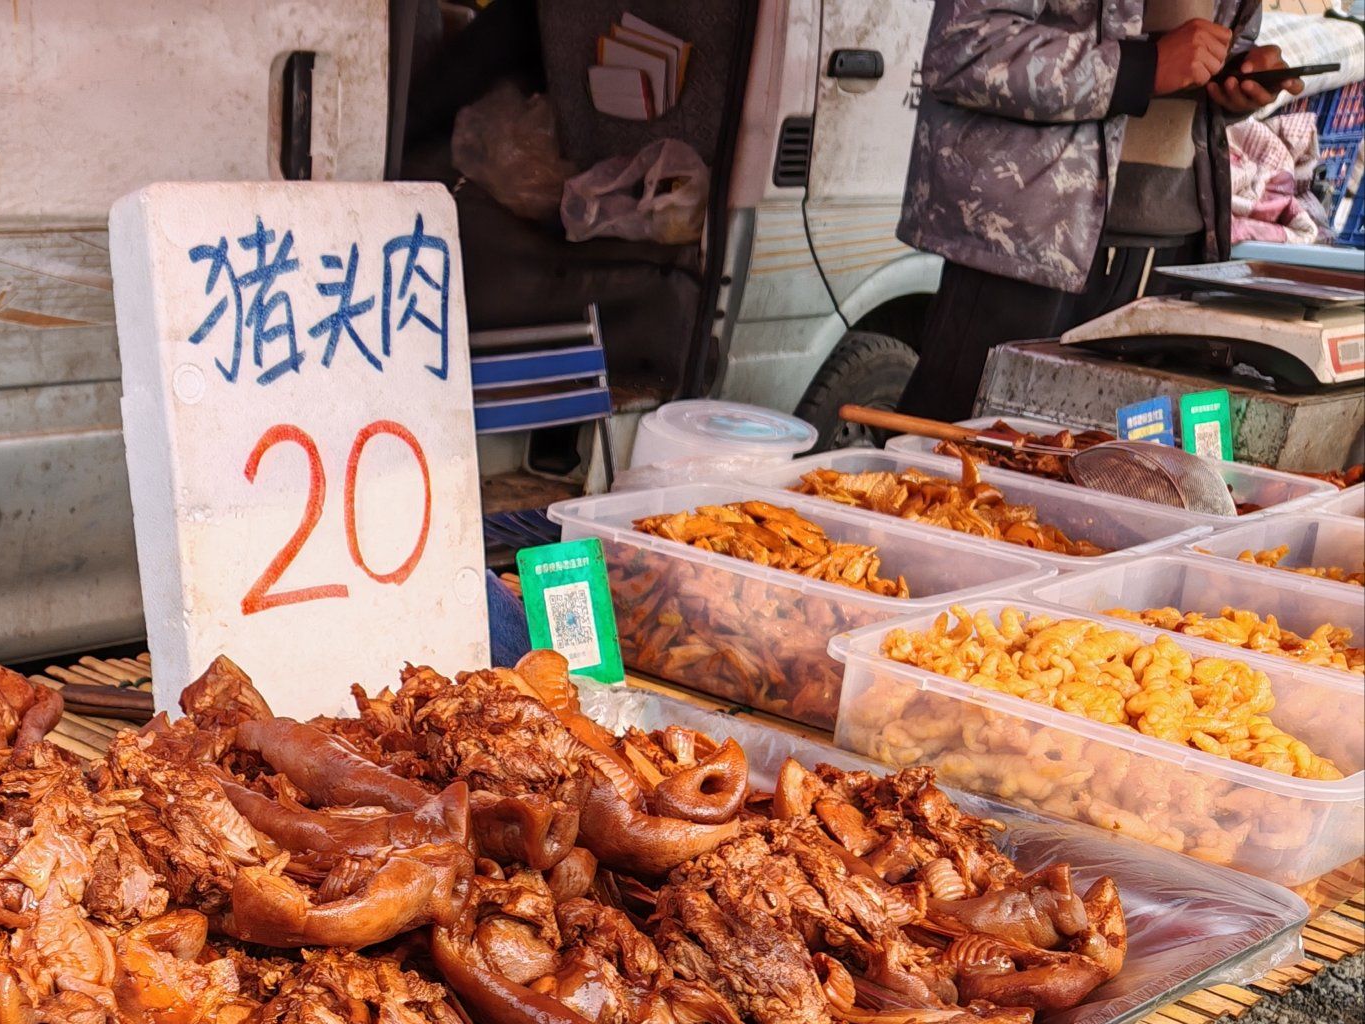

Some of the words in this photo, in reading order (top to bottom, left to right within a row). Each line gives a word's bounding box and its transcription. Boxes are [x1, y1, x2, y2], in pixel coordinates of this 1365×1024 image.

[188, 213, 451, 386] 猪头肉
[240, 419, 432, 616] 20
